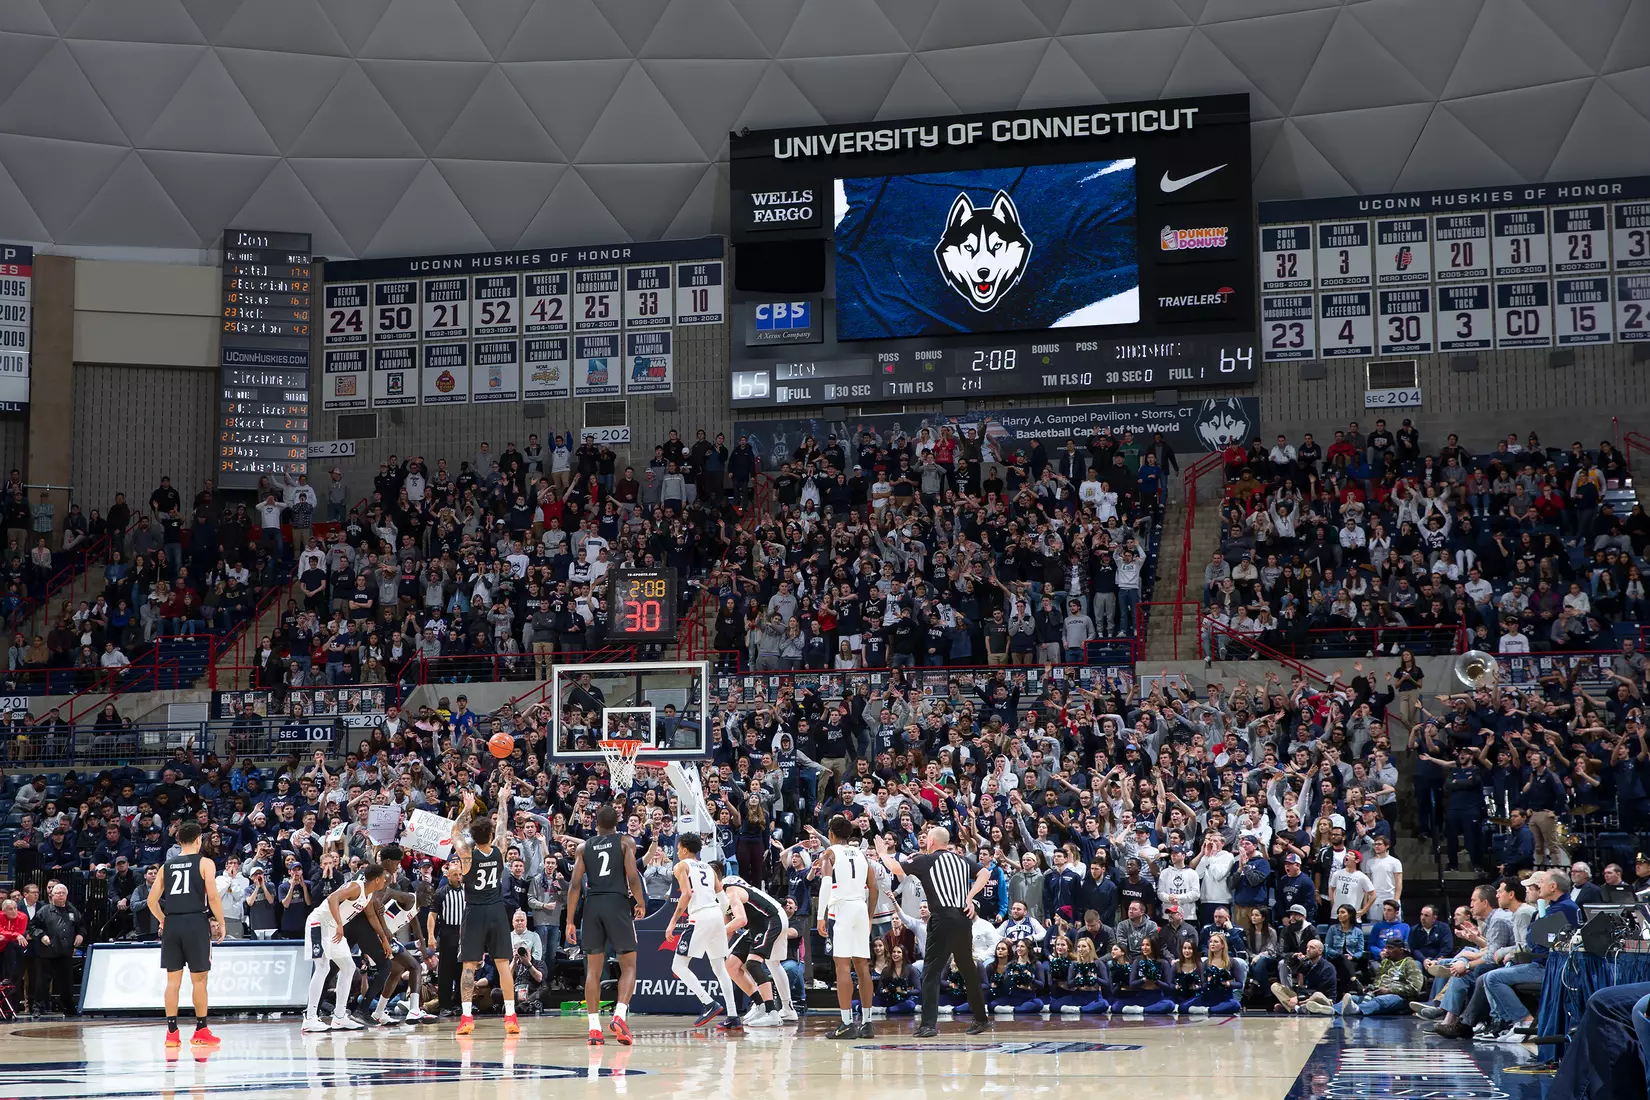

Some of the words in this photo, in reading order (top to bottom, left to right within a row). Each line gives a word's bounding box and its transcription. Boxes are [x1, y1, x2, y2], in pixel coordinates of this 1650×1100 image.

[774, 126, 938, 159] UNIVERSITY
[947, 122, 983, 146] OF
[992, 108, 1199, 142] CONNECTICUT
[751, 190, 813, 206] WELLS
[1359, 197, 1421, 211] UCONN
[1432, 190, 1513, 207] HUSKIES
[1525, 188, 1547, 200] OF
[1558, 183, 1622, 197] HONOR
[753, 207, 813, 223] FARGO
[1504, 223, 1536, 235] CHARLES
[1567, 219, 1592, 231] MOORE
[1179, 227, 1228, 239] DUNKIN'
[1179, 238, 1226, 249] DONUTS
[1276, 239, 1296, 249] CASH
[1568, 233, 1593, 261] 23
[1450, 241, 1474, 268] 20
[1510, 238, 1531, 265] 31
[410, 259, 463, 271] UCONN
[472, 254, 541, 267] HUSKIES
[550, 252, 568, 263] OF
[578, 248, 632, 261] HONOR
[1276, 252, 1297, 279] 32
[1339, 250, 1350, 275] 3
[1323, 277, 1367, 286] 2000-2004
[536, 284, 557, 295] SALES
[228, 293, 237, 302] 10
[639, 291, 658, 316] 33
[691, 288, 709, 313] 10
[1158, 293, 1222, 308] TRAVELERS
[1454, 298, 1474, 309] TUCK
[224, 307, 237, 317] 23
[480, 300, 511, 325] 52
[530, 297, 564, 322] 42
[585, 294, 610, 319] 25
[1326, 304, 1366, 317] JEFFERSON
[1387, 301, 1421, 314] STEWART
[330, 309, 363, 334] 24
[379, 306, 412, 331] 50
[432, 303, 460, 328] 21
[1570, 305, 1596, 332] 15
[224, 322, 237, 331] 25
[1388, 315, 1421, 343] 30
[1456, 312, 1472, 339] 3
[1506, 309, 1540, 336] CD
[763, 332, 782, 340] Xerox
[782, 331, 811, 339] Company
[1271, 322, 1304, 349] 23
[1338, 319, 1354, 345] 4
[1032, 344, 1060, 354] BONUS
[1076, 341, 1098, 351] POSS
[878, 353, 900, 362] POSS
[915, 350, 943, 360] BONUS
[971, 349, 1016, 371] 2:08
[1219, 347, 1253, 373] 64
[1042, 374, 1057, 386] TM
[1060, 373, 1078, 385] FLS
[1106, 372, 1119, 383] 30
[1122, 370, 1142, 382] SEC
[1169, 368, 1193, 380] FULL
[738, 372, 768, 398] 65
[836, 386, 849, 397] 30
[851, 384, 871, 396] SEC
[898, 383, 913, 394] TM
[915, 381, 934, 393] FLS
[788, 387, 811, 400] FULL
[1366, 395, 1385, 403] SEC
[1387, 391, 1421, 404] 204
[1002, 416, 1031, 428] Harry
[1033, 415, 1044, 424] A.
[1047, 413, 1087, 425] Gampel
[1090, 410, 1131, 422] Pavilion
[1141, 409, 1176, 420] Storrs,
[1178, 408, 1193, 417] CT
[601, 429, 629, 441] 202
[1016, 428, 1071, 439] Basketball
[1113, 424, 1125, 434] of
[1147, 422, 1180, 433] World
[222, 447, 234, 455] 33
[308, 445, 324, 454] SEC
[330, 442, 355, 454] 201
[221, 461, 233, 470] 34
[630, 580, 665, 598] 2:08
[625, 600, 660, 632] 30
[872, 643, 879, 652] 15
[3, 697, 27, 708] 201
[280, 730, 298, 739] SEC
[304, 727, 332, 740] 101
[883, 737, 891, 747] 15
[777, 760, 795, 768] UCONN
[597, 851, 611, 877] 2
[848, 858, 856, 879] 1
[170, 870, 190, 895] 21
[474, 867, 498, 890] 34
[699, 870, 709, 887] 2
[1338, 875, 1359, 884] UCONN
[983, 886, 993, 897] 15
[1122, 889, 1142, 898] UCONN
[1341, 883, 1350, 895] 15
